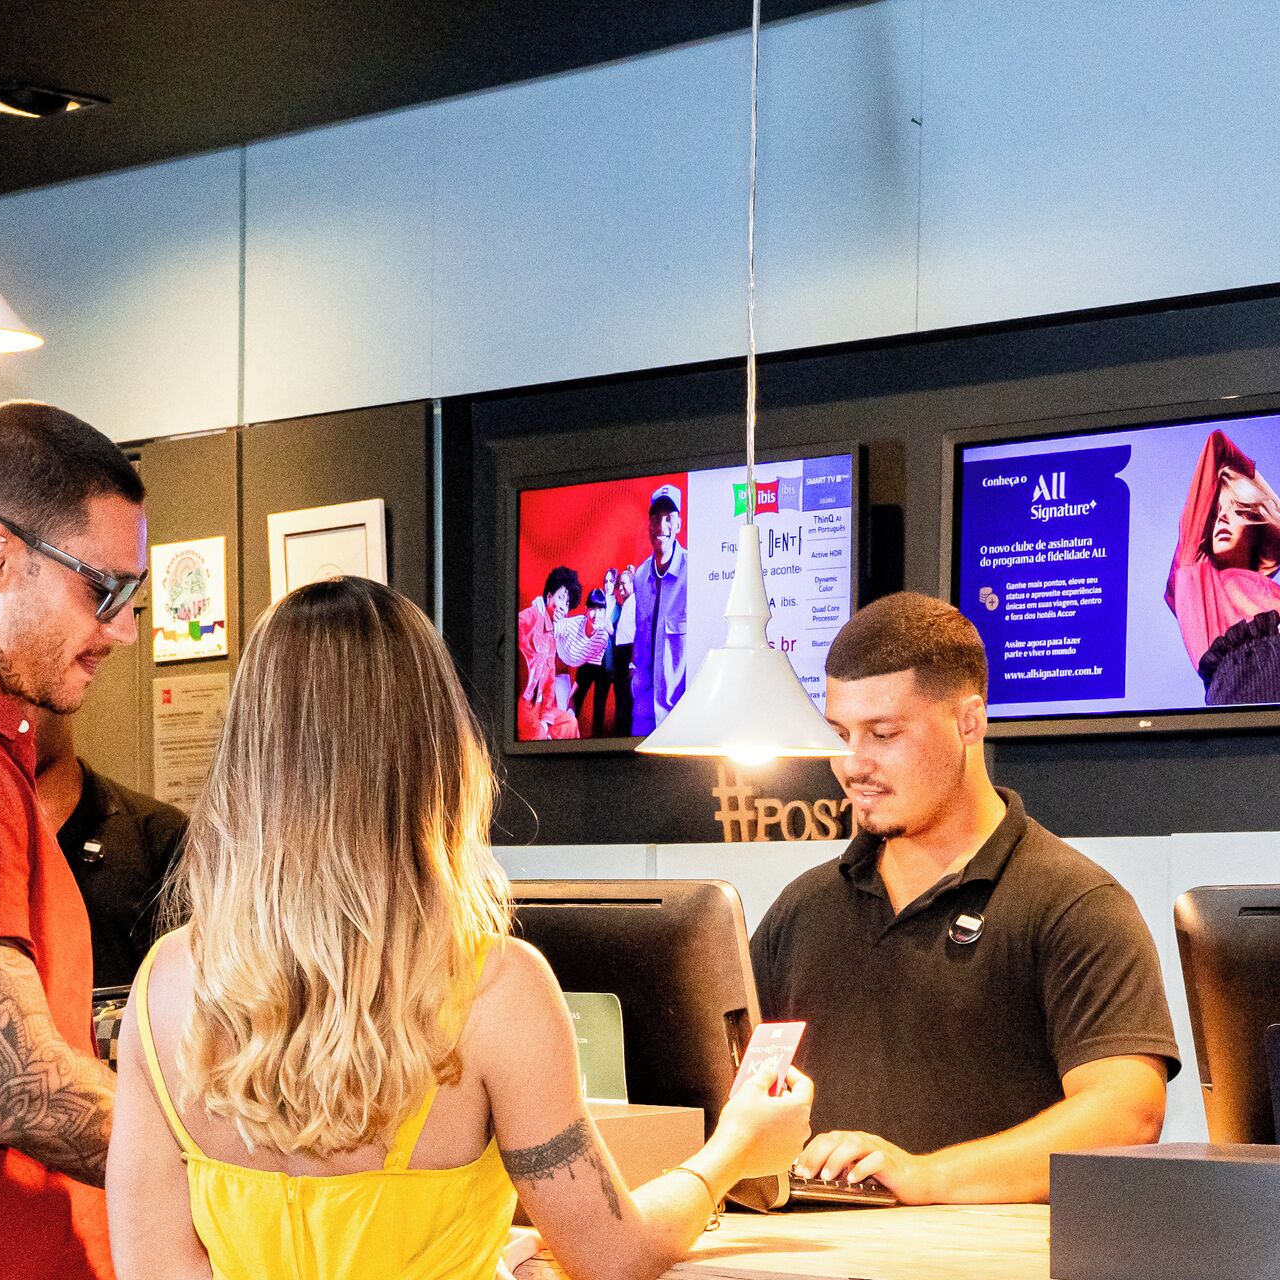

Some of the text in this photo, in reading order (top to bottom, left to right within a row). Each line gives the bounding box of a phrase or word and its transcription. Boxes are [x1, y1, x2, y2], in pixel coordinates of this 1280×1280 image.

[983, 475, 1019, 487] Conheça
[1032, 472, 1065, 502] All
[758, 490, 776, 504] ibis
[980, 538, 1092, 554] O novo clube de assinatura
[980, 548, 1107, 568] do programa de fidelidade ALL
[1006, 582, 1026, 590] Ganhe
[1028, 580, 1042, 589] mais
[1044, 578, 1067, 589] pontos,
[1006, 592, 1025, 600] status
[1031, 589, 1061, 600] aproveite
[1062, 586, 1102, 597] experiências
[1006, 601, 1025, 611] únicas
[1053, 598, 1079, 609] viagens,
[1080, 597, 1102, 606] dentro
[1005, 665, 1103, 680] www.allsignature.com.br
